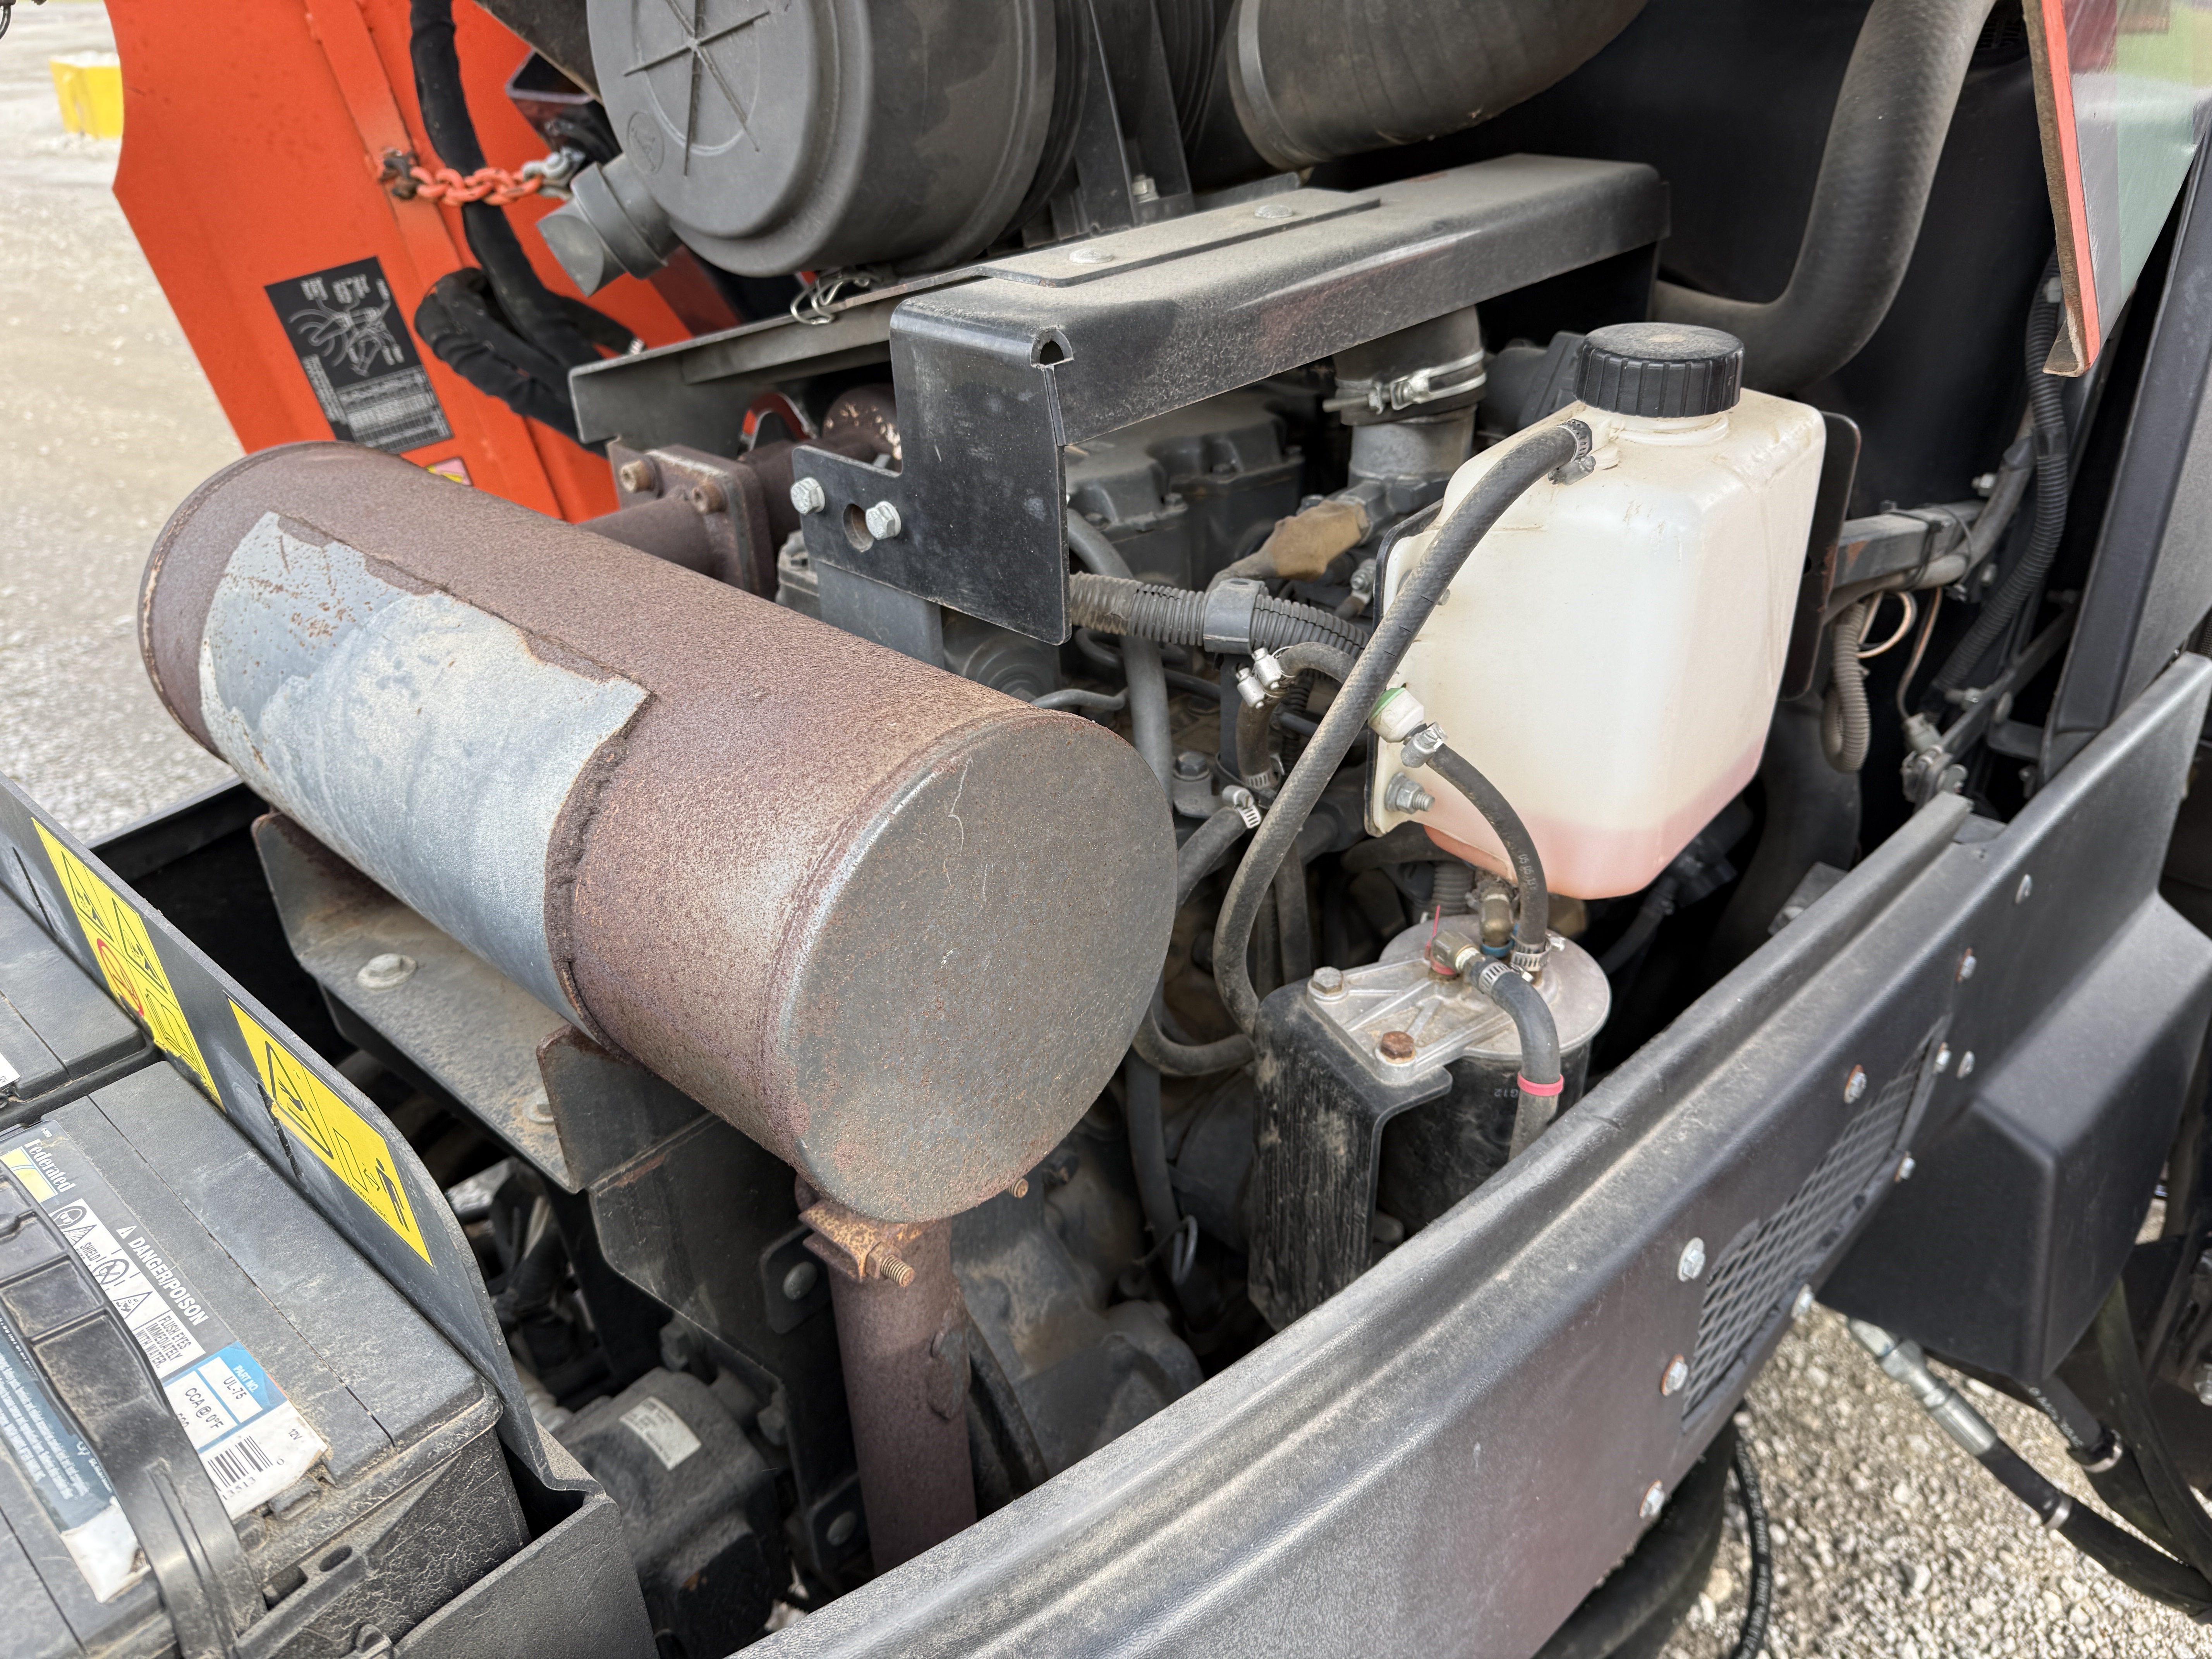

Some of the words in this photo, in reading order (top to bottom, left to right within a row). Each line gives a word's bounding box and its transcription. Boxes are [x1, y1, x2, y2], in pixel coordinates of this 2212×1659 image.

[24, 1139, 76, 1193] Federated
[80, 1242, 101, 1261] SHIELD
[128, 1237, 209, 1326] DANGER/POISON
[135, 1329, 153, 1346] WITH
[146, 1322, 183, 1361] IMMEDIATELY
[158, 1315, 181, 1336] FLUSH
[171, 1332, 191, 1350] EYES
[233, 1365, 252, 1382] PART
[185, 1388, 205, 1408] CCA
[288, 1429, 303, 1440] 12V
